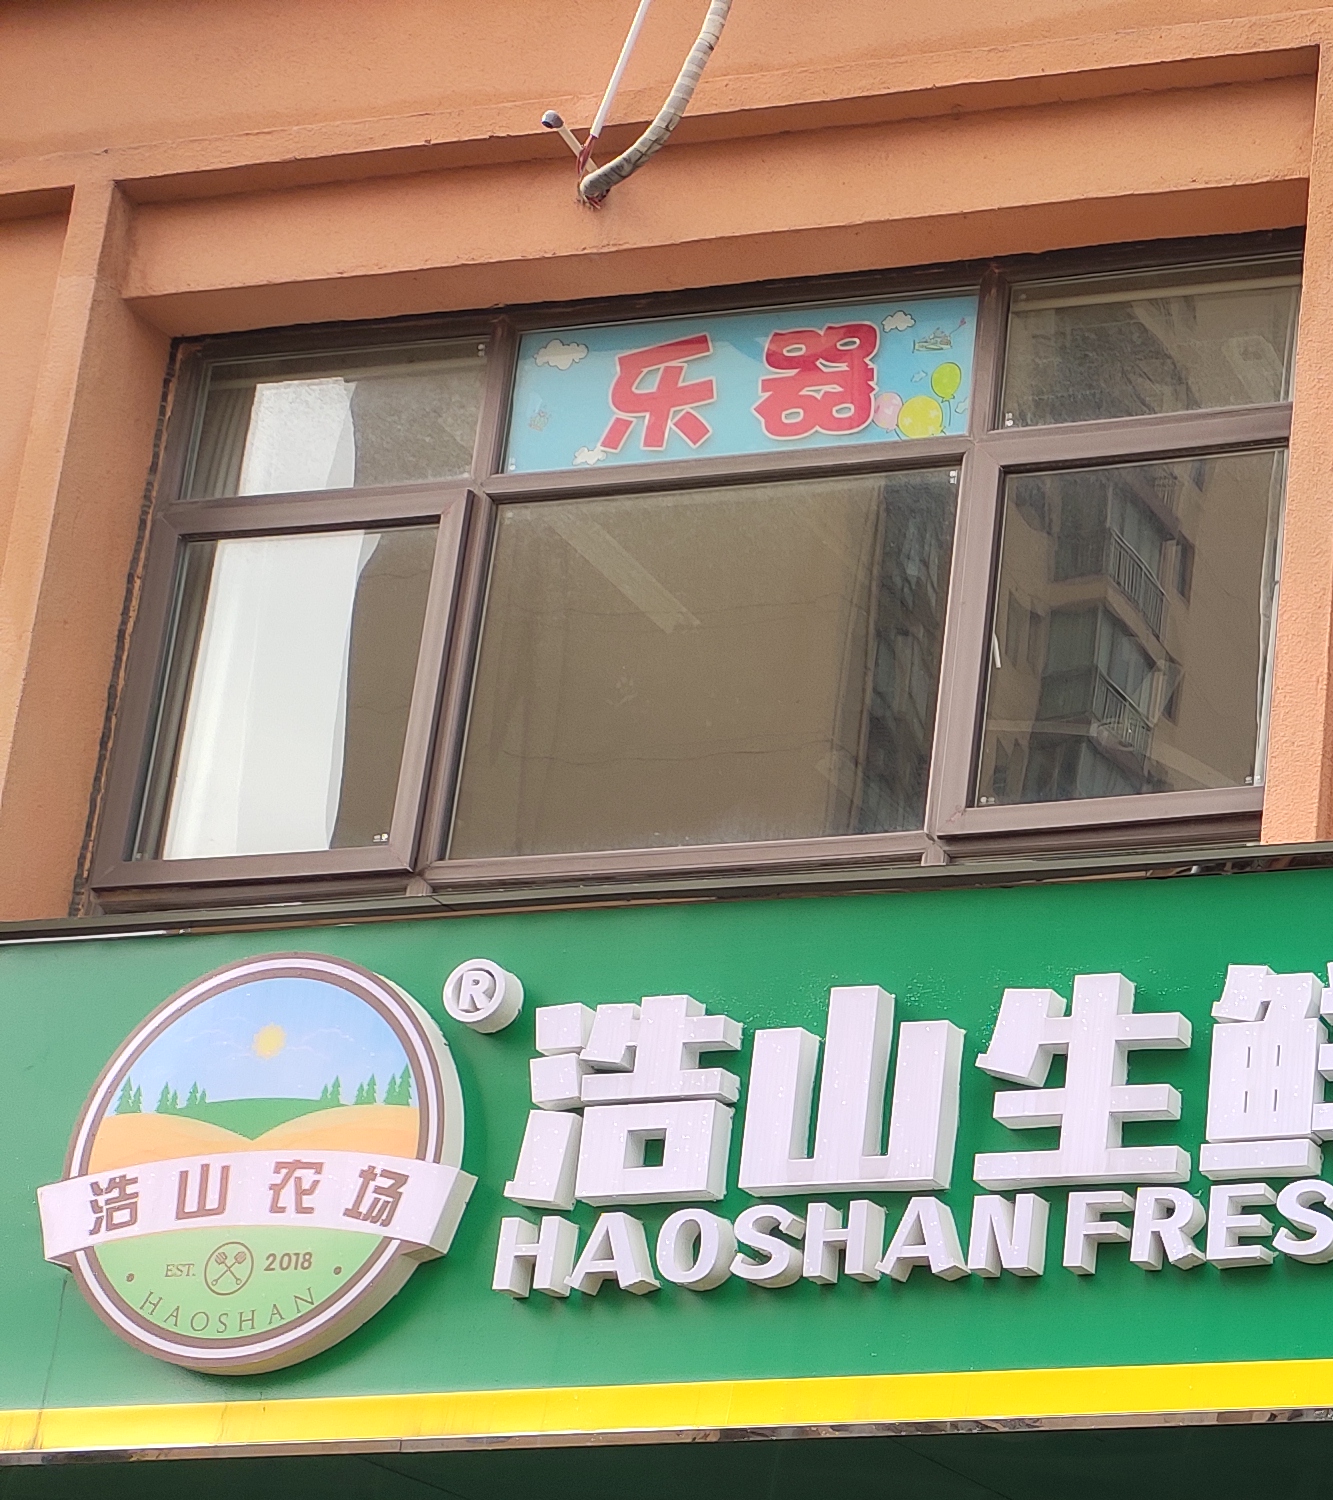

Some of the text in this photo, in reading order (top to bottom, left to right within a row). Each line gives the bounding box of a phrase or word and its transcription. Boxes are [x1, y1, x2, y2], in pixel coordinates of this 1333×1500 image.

[600, 322, 880, 452] 乐器
[88, 1158, 411, 1236] 浩山农场
[164, 1252, 313, 1278] EST. 2018
[138, 1287, 316, 1334] HAOSHAN
